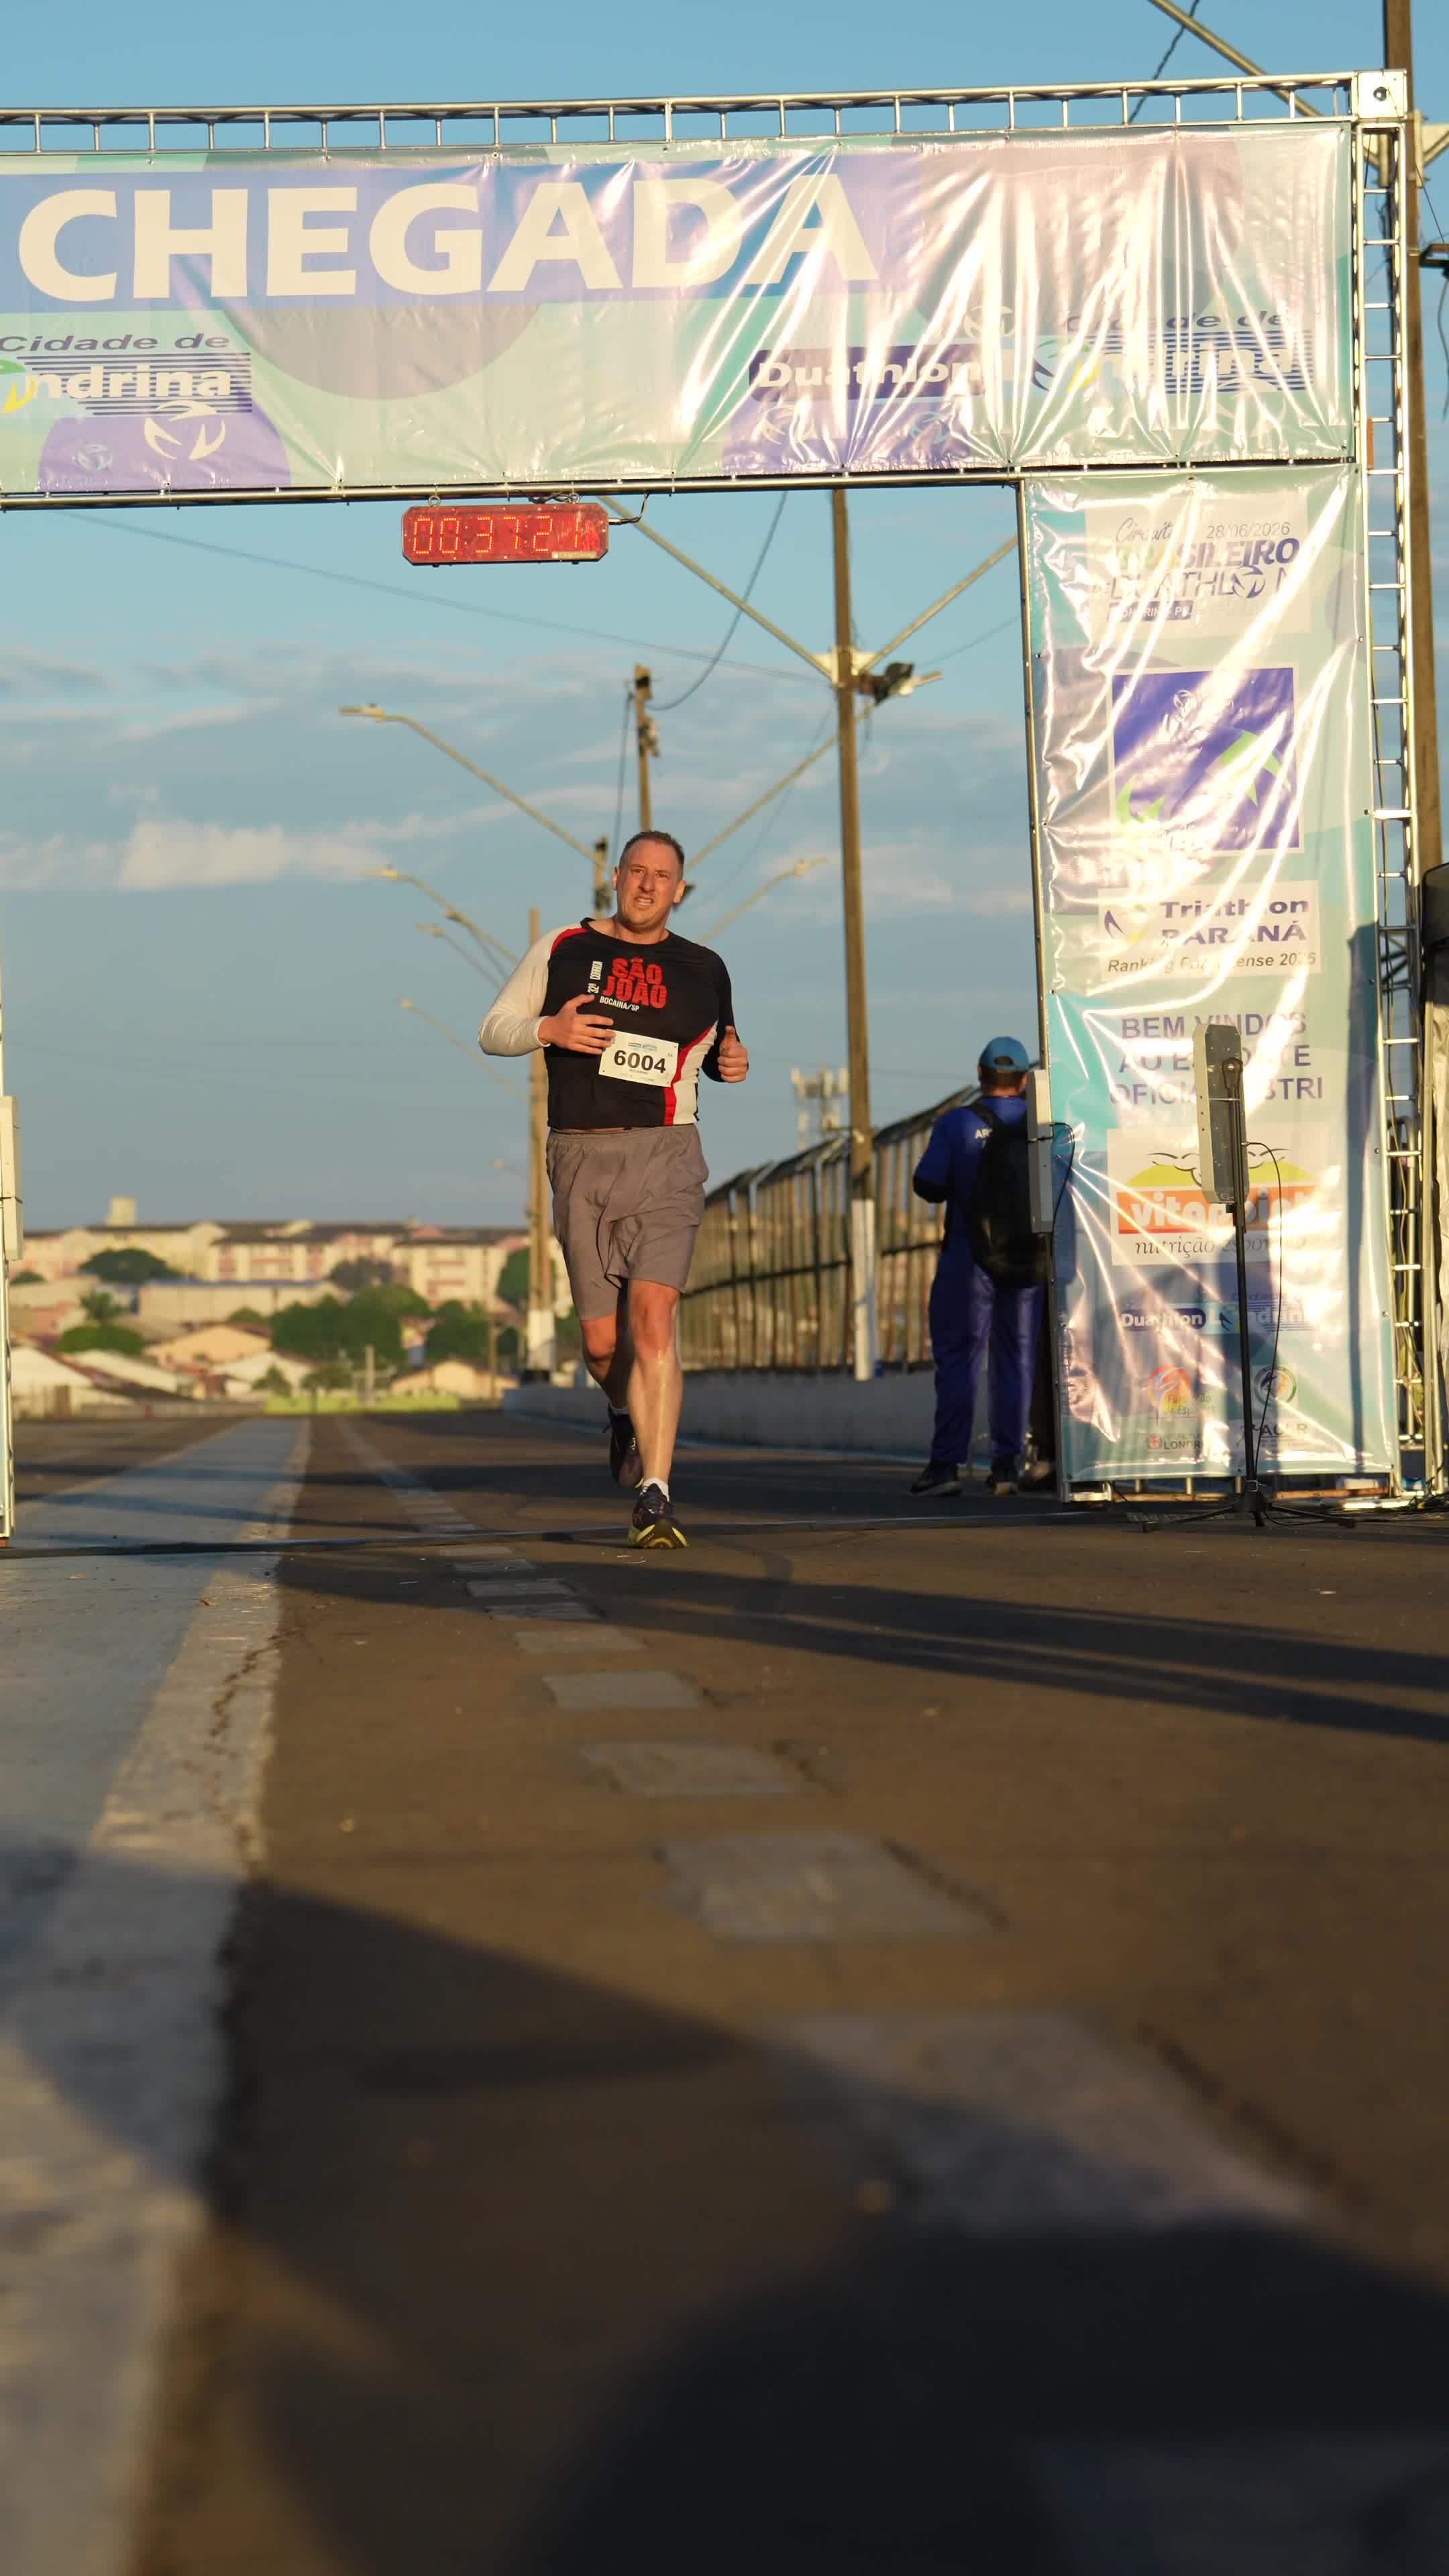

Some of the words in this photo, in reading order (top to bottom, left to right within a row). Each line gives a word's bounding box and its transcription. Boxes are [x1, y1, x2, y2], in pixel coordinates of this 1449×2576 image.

[19, 174, 879, 301] CHEGADA
[0, 334, 158, 352] Cidade
[174, 333, 230, 349] de
[1116, 517, 1177, 541] Circuit
[1207, 521, 1290, 539] 28/06/2026
[1116, 538, 1299, 570] SILEIRO
[1160, 898, 1308, 921] Triathon
[612, 957, 662, 985] SÃO
[1280, 952, 1316, 966] 206
[602, 975, 667, 1008] JOÃO
[599, 996, 639, 1012] BOCAINA/SP
[1122, 1016, 1185, 1039] BEM
[1193, 1013, 1307, 1036] VNDS
[614, 1050, 666, 1074] 6004
[1135, 1235, 1215, 1259] nurição
[1122, 1312, 1203, 1327] Duahlon
